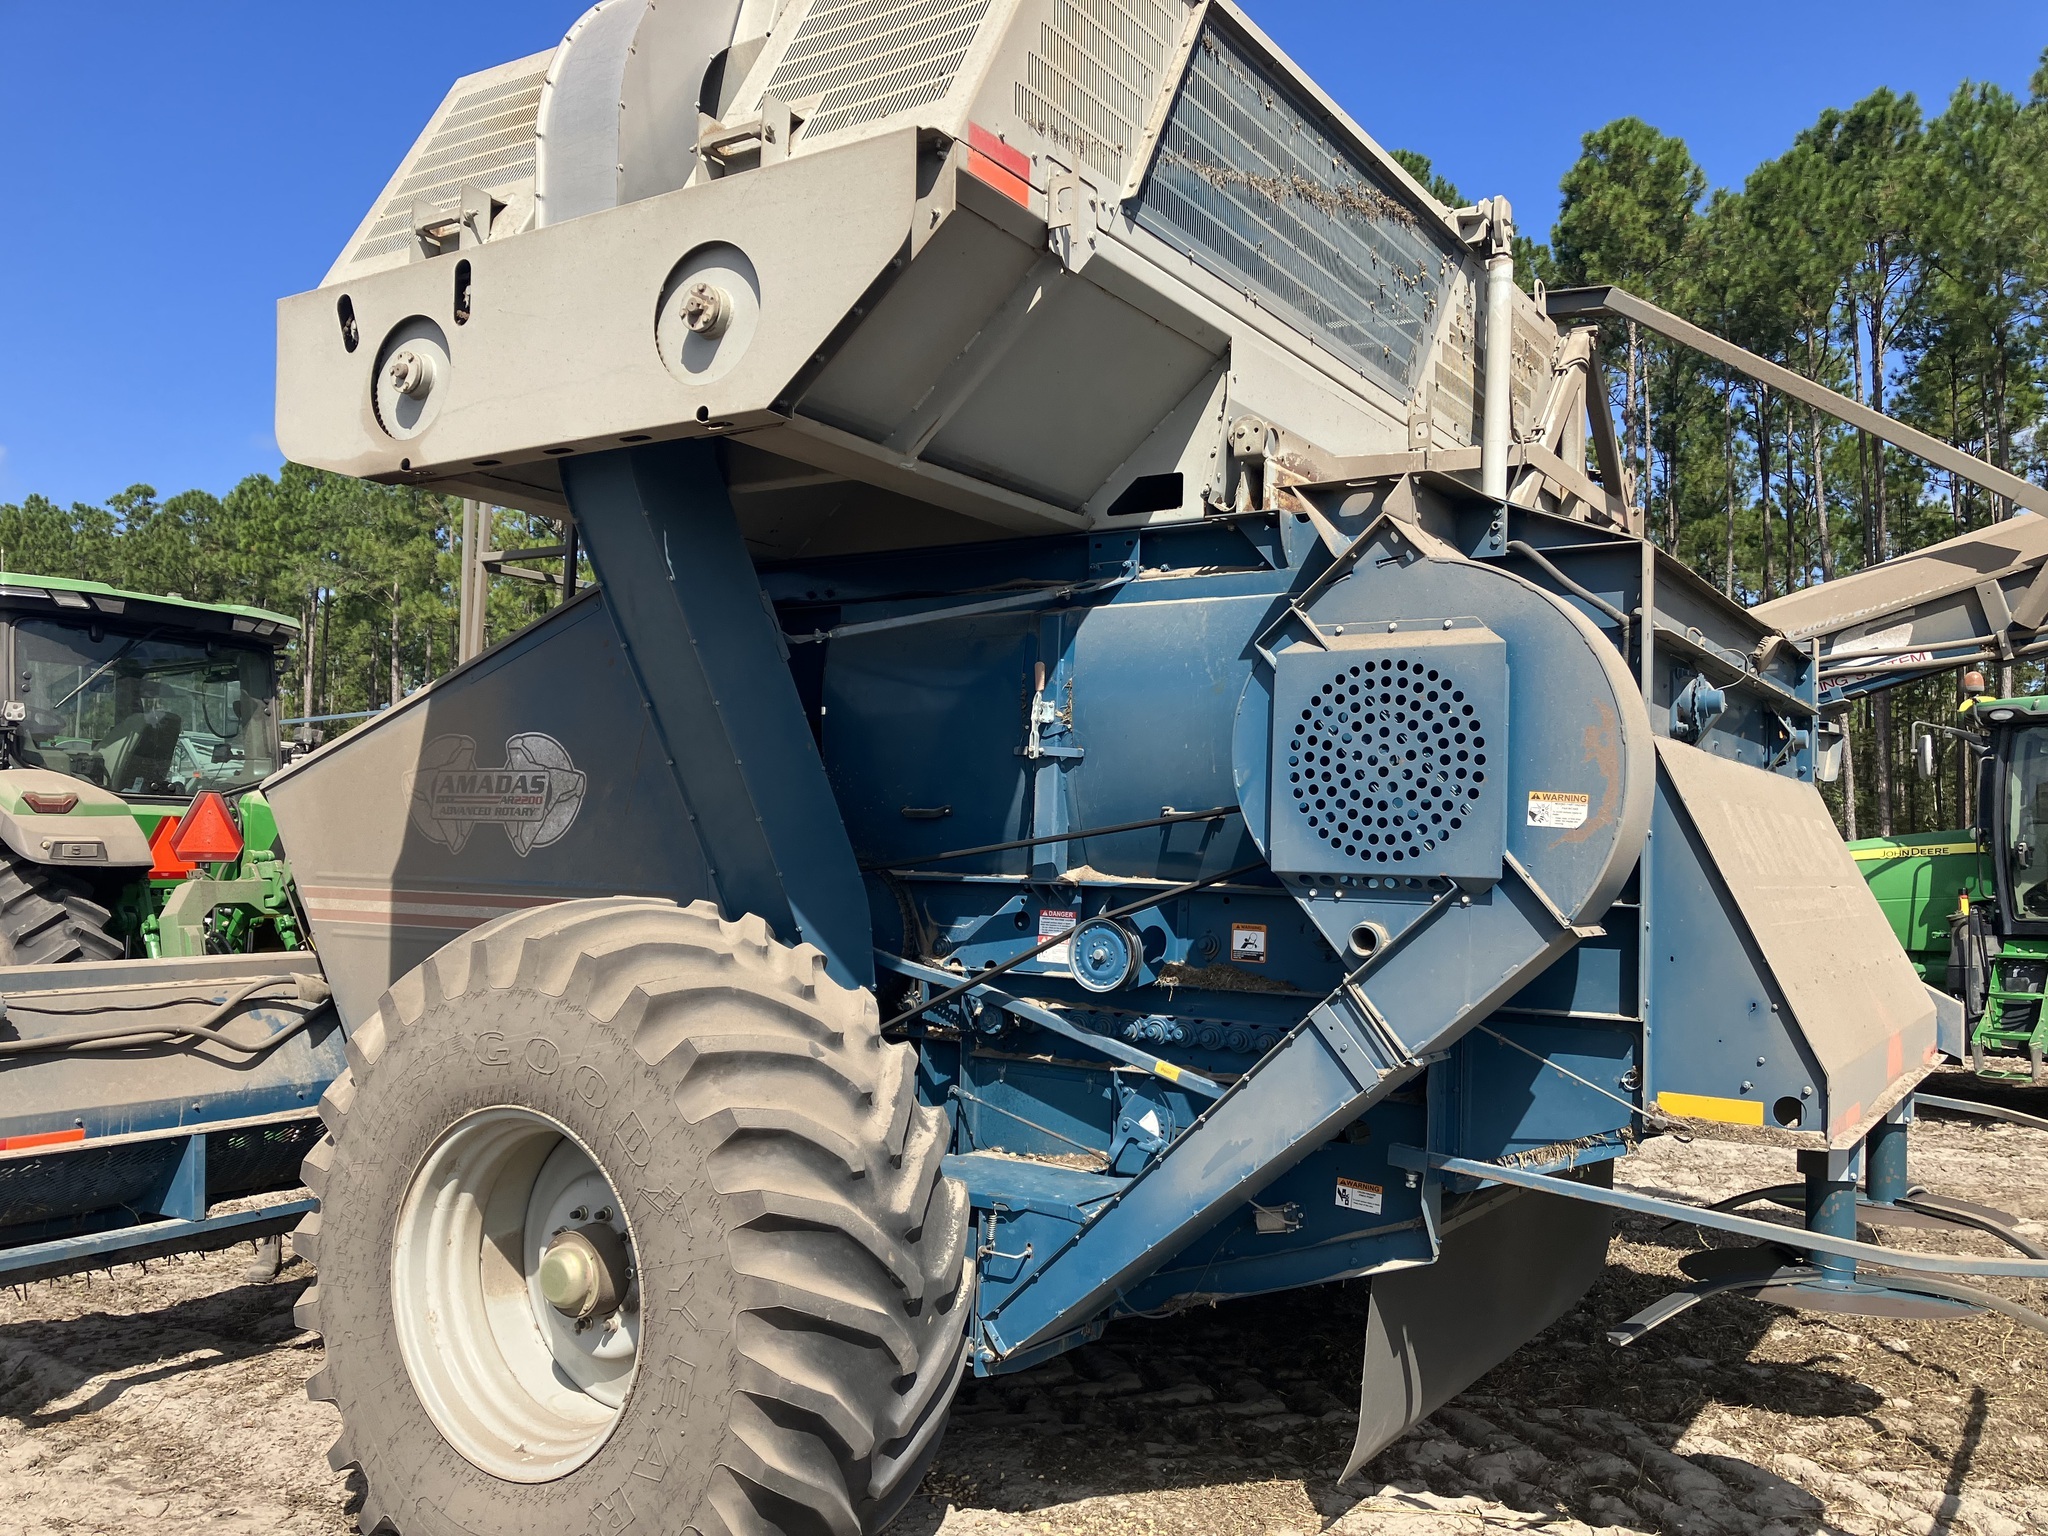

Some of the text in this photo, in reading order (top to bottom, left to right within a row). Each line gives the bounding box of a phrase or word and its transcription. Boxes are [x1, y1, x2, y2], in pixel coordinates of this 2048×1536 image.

[437, 775, 546, 794] AMADAS
[499, 796, 543, 805] AR2200
[1542, 793, 1587, 803] WARNING
[440, 806, 491, 816] ADVANCED
[1881, 847, 1949, 858] JOHN DEERE
[1048, 910, 1074, 918] DANGER
[1346, 1180, 1380, 1192] WARNING
